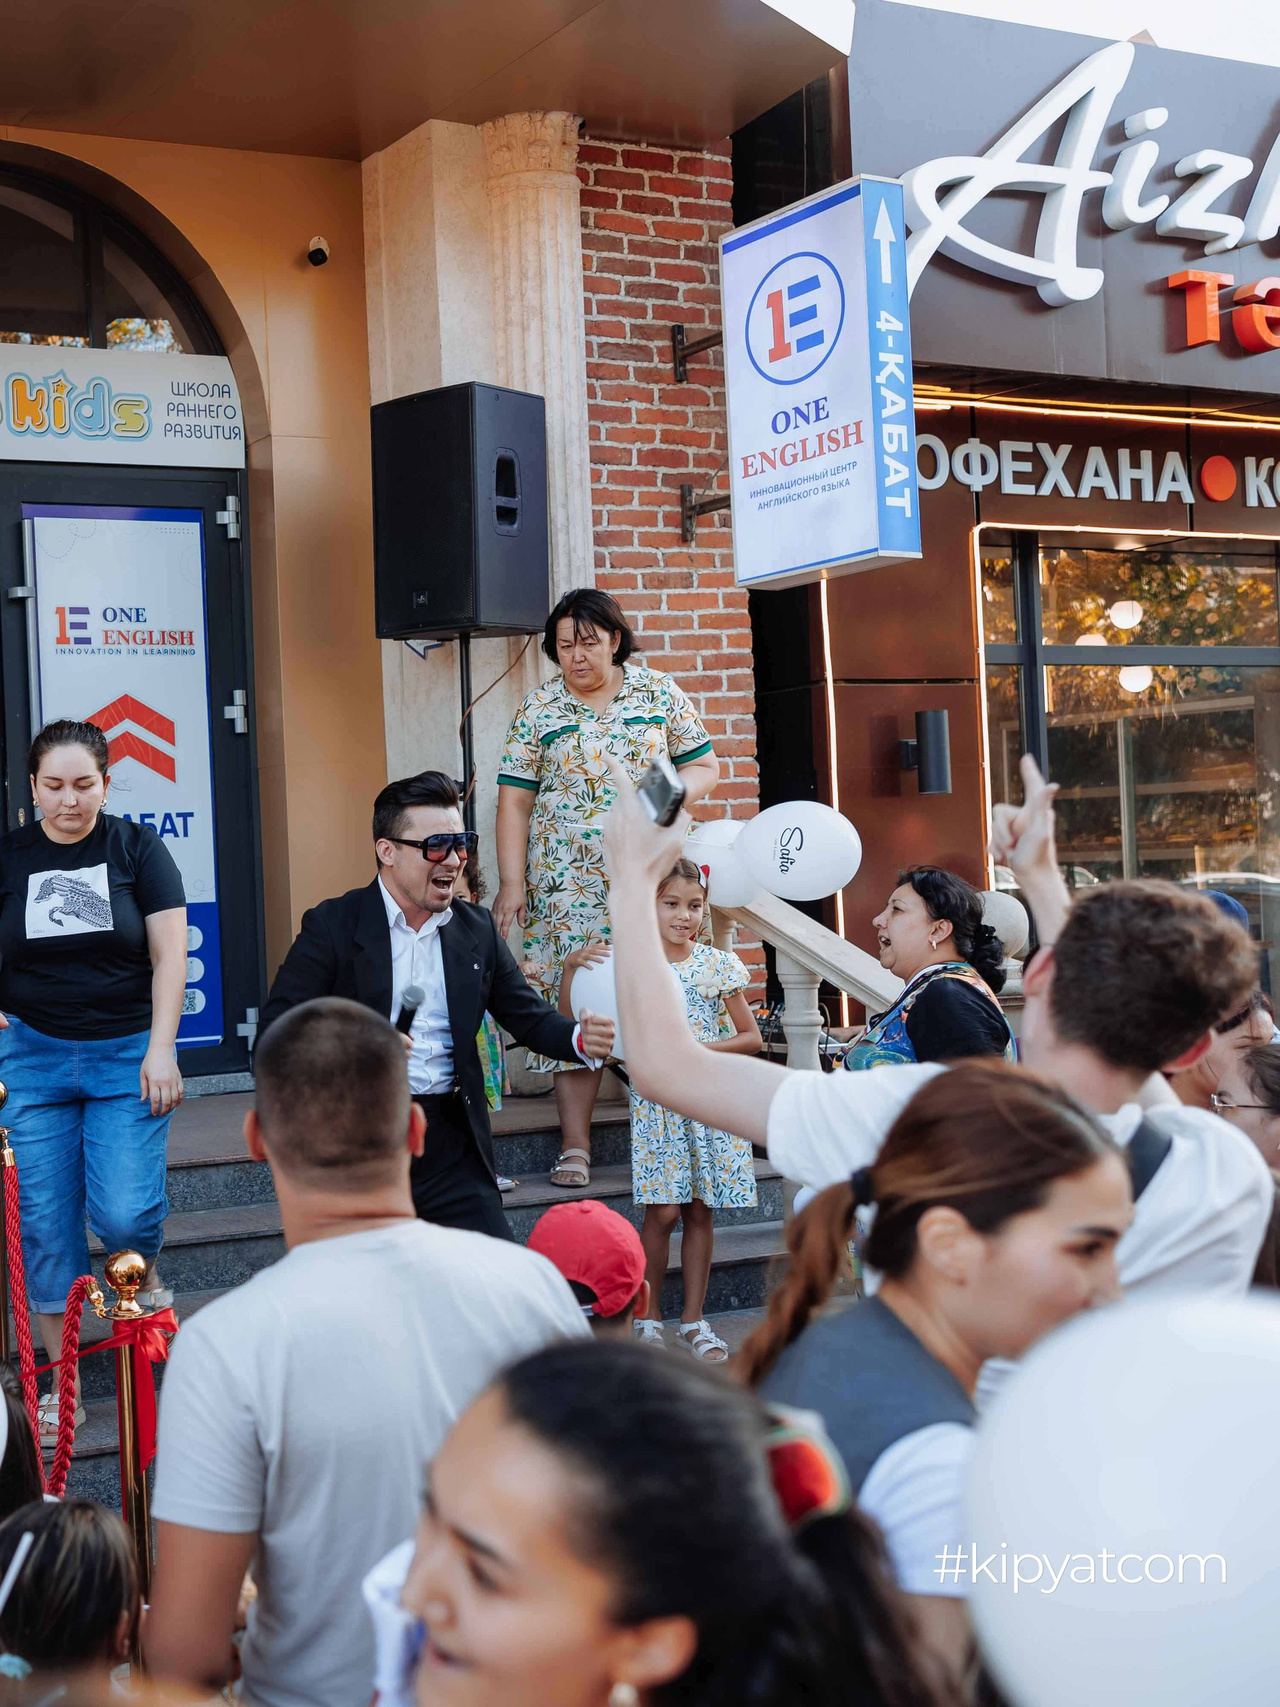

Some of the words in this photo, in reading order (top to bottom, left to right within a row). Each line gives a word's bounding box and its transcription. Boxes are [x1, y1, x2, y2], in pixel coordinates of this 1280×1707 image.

[171, 381, 231, 398] ШКОЛА
[167, 402, 237, 420] РАННЕГО
[771, 396, 830, 435] ONE
[164, 423, 242, 441] РАЗВИТИЯ
[740, 420, 864, 479] ENGLISH
[749, 469, 829, 499] ИННОВАЦИОННЫЙ
[830, 461, 858, 479] ЦЕНТР
[1244, 456, 1280, 508] К
[757, 486, 820, 511] АНГЛИЙСКОГО
[821, 478, 851, 494] ЯЗЫКА
[102, 606, 147, 623] ONE
[102, 629, 195, 646] ENGLISH
[143, 648, 196, 656] LEARNING
[779, 826, 803, 875] Safia
